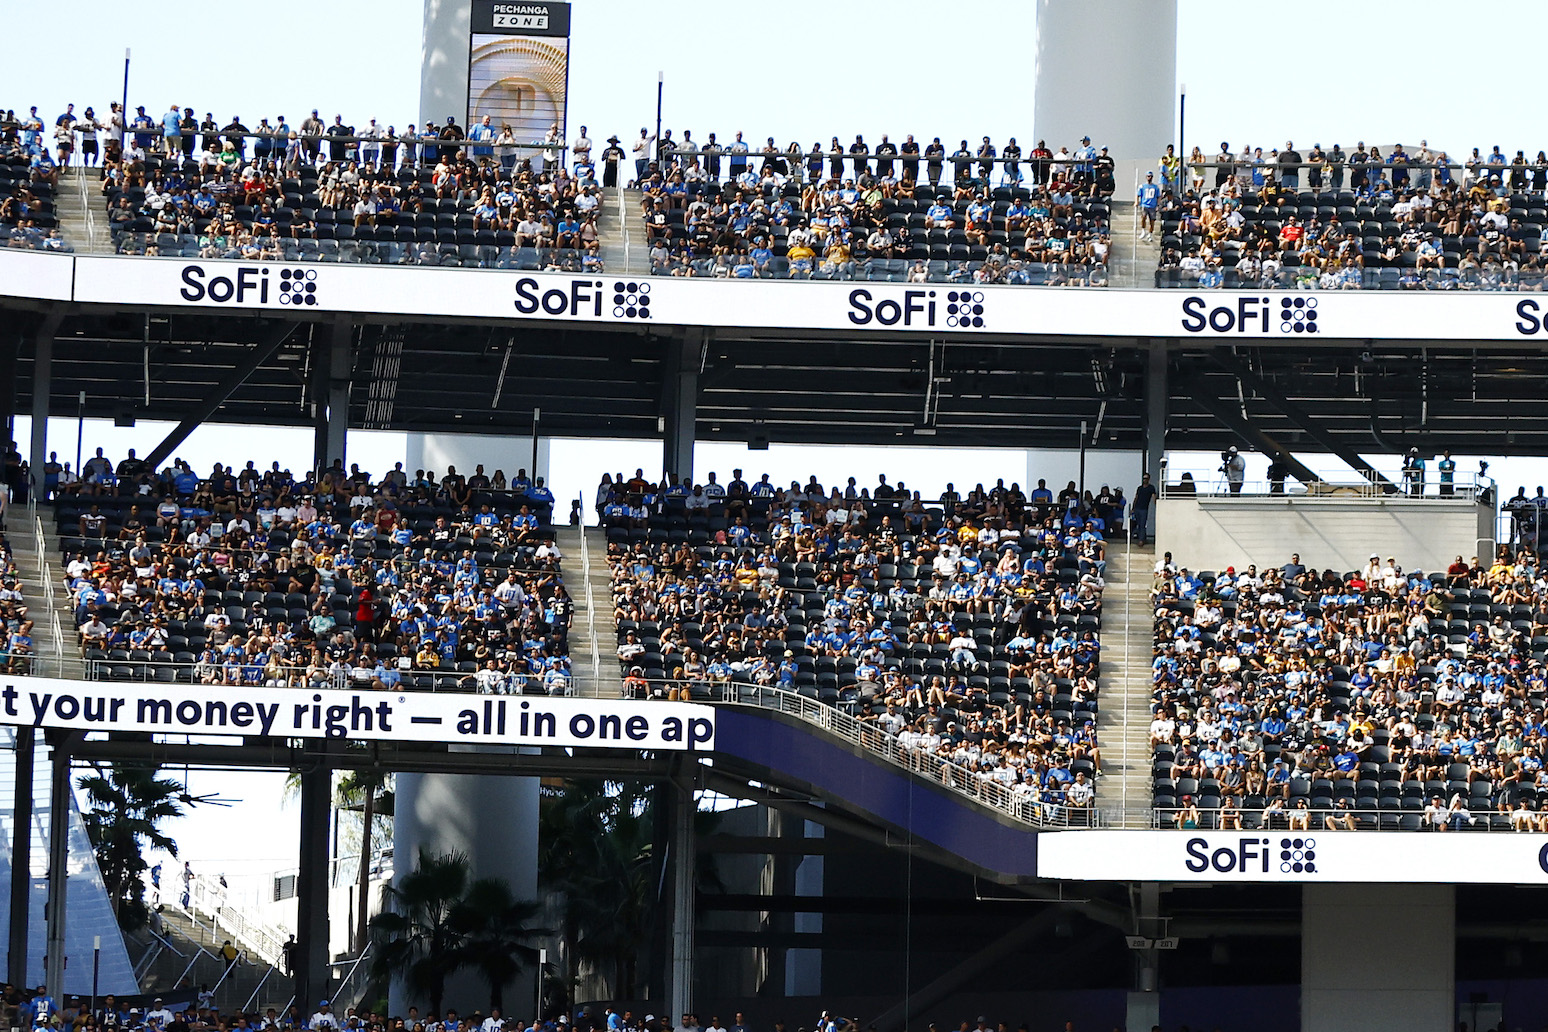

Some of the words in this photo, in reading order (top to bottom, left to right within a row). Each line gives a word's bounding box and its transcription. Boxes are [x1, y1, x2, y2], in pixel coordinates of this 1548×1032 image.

[493, 5, 549, 14] PECHANGA
[498, 17, 544, 26] ZONE
[1146, 188, 1155, 199] 10
[180, 266, 269, 304] SoFi
[515, 277, 604, 318] SoFi
[848, 289, 937, 327] SoFi
[1182, 297, 1269, 332] SoFi
[253, 618, 264, 629] 17
[29, 692, 125, 726] your
[137, 698, 280, 737] money
[457, 700, 506, 736] all
[520, 702, 557, 738] in
[569, 713, 649, 741] one
[1186, 838, 1269, 872] SoFi
